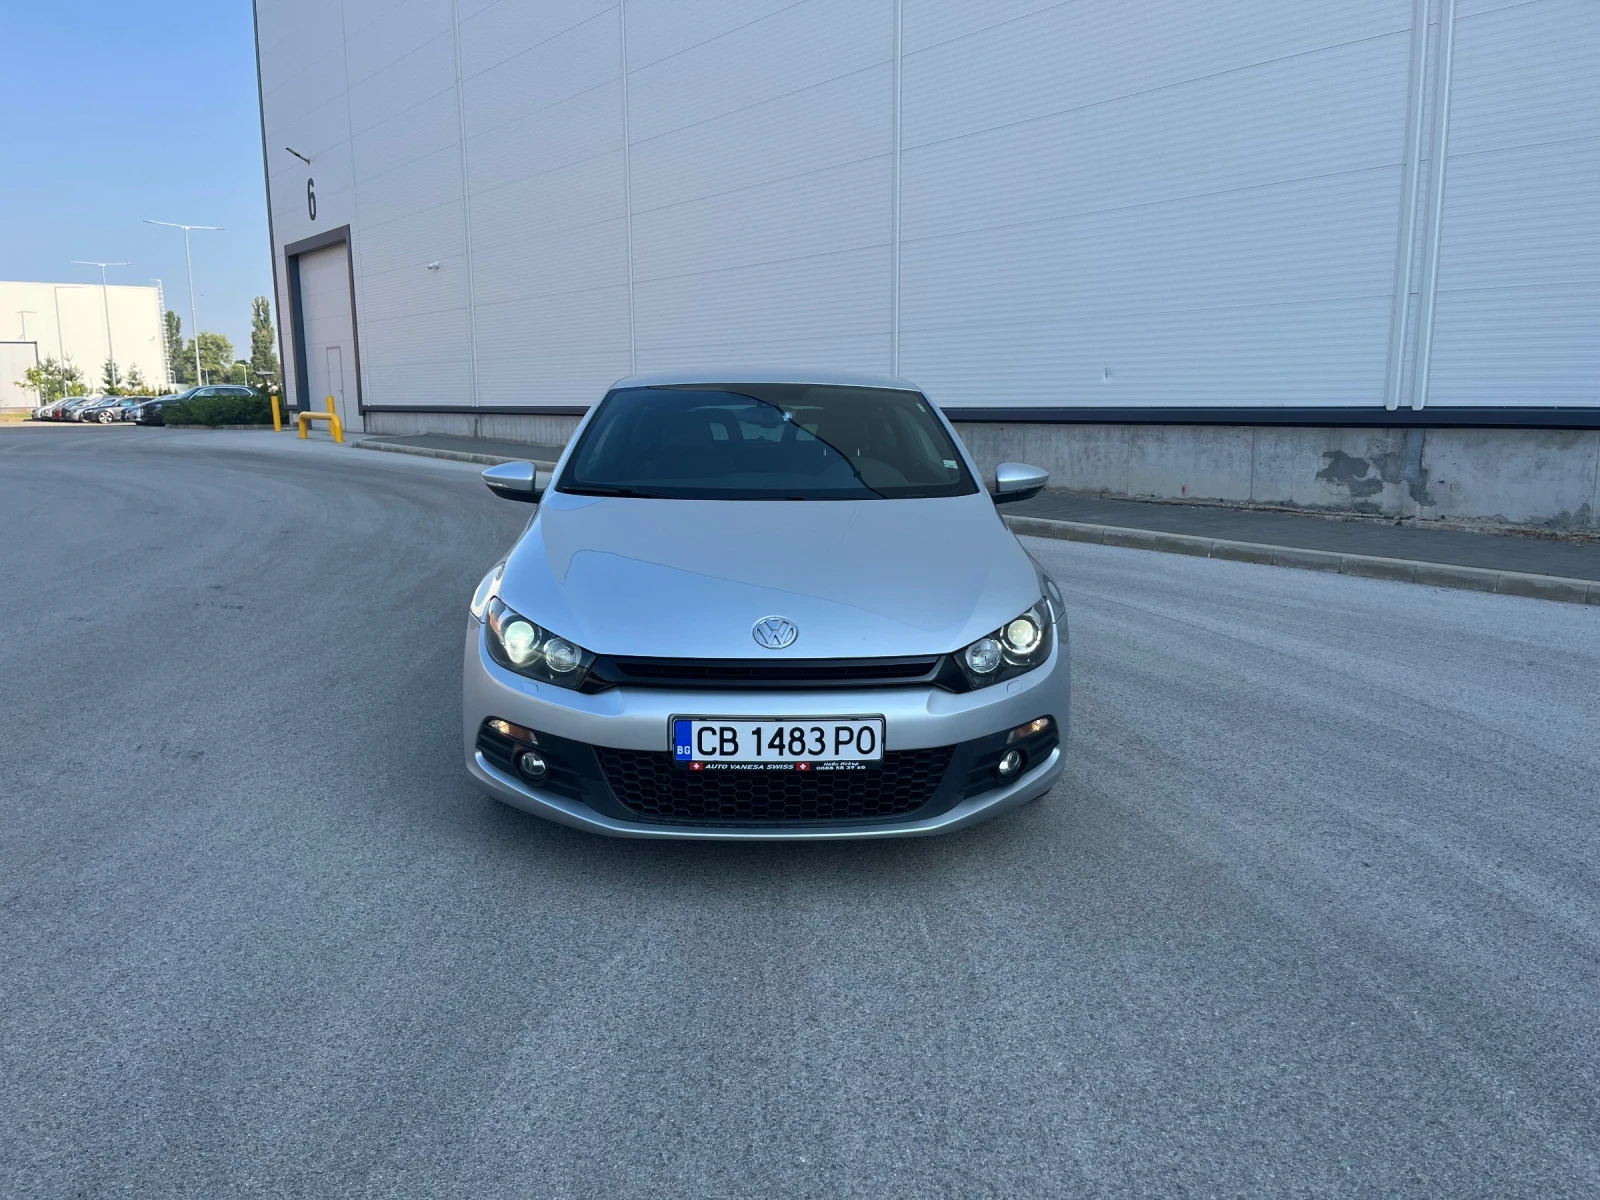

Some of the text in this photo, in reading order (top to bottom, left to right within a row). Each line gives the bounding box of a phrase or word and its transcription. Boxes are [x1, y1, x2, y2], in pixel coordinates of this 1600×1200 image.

[307, 177, 317, 221] 6
[676, 745, 691, 755] BG
[697, 726, 739, 756] CB
[751, 726, 826, 756] 1483
